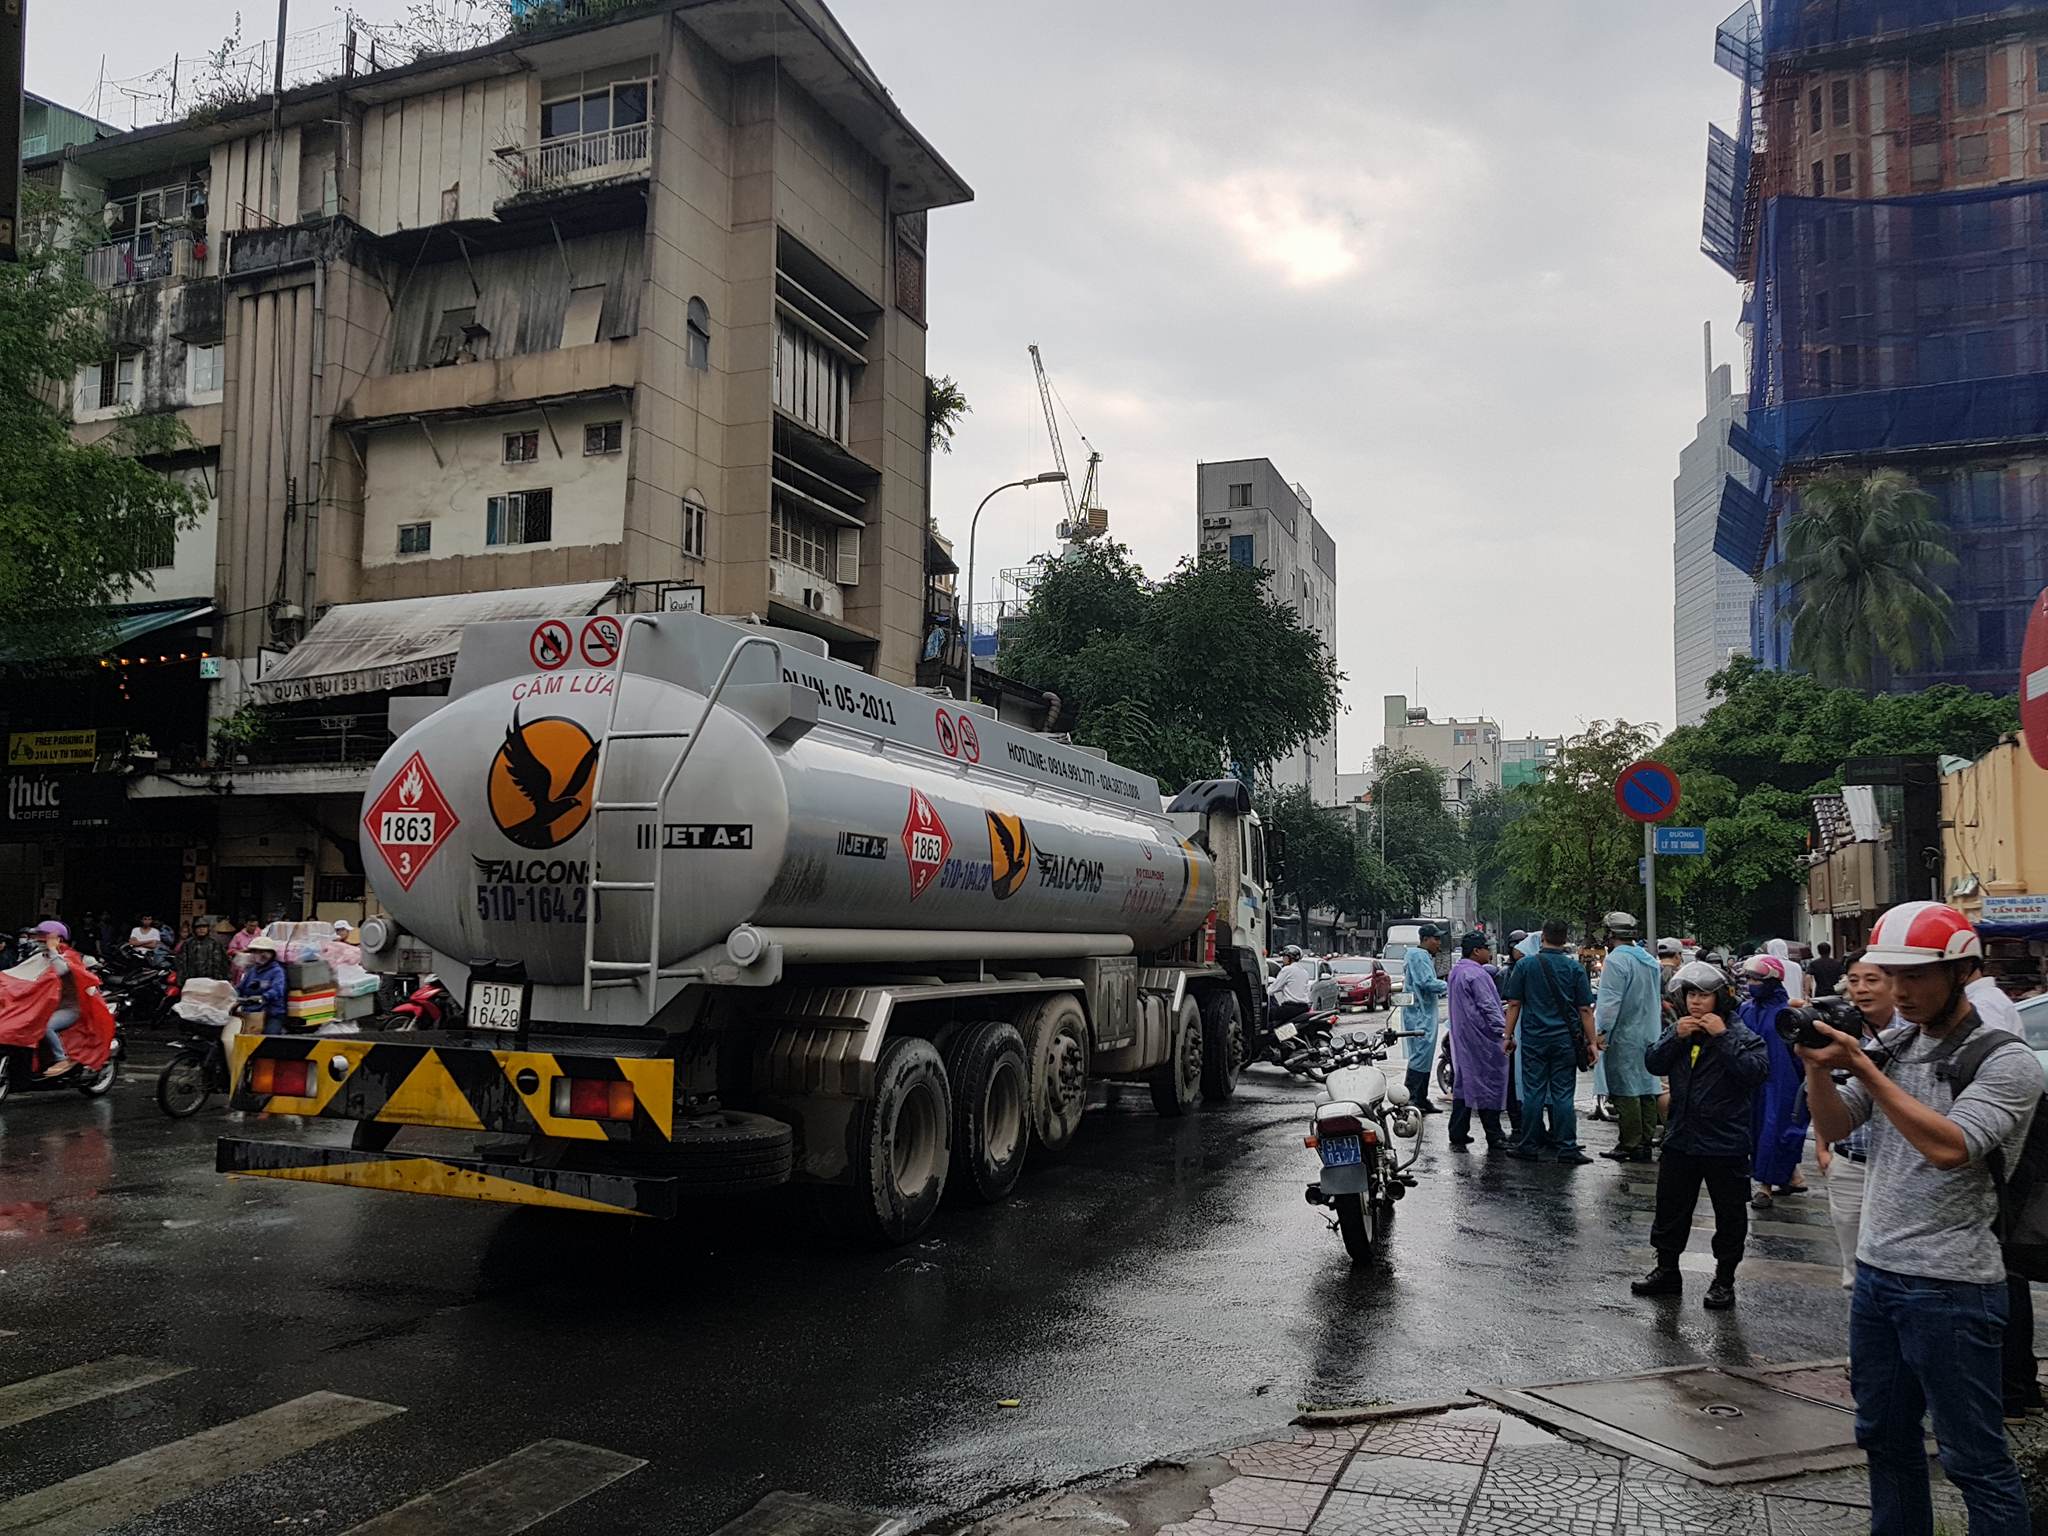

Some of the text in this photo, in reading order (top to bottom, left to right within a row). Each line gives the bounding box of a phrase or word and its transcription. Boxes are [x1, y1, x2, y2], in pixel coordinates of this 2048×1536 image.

[274, 681, 311, 700] QUAN
[315, 679, 338, 694] BUI
[342, 677, 357, 692] 39
[512, 672, 563, 701] CẤM
[834, 684, 897, 726] 05-2011
[34, 734, 95, 746] FREE PARKING AT
[1007, 741, 1048, 772] HOTLINE:
[16, 810, 60, 820] COFFEE
[383, 817, 432, 842] 1863
[663, 826, 751, 846] JET A-1
[847, 835, 888, 857] JET A-1
[914, 836, 941, 862] 1863
[399, 852, 412, 875] 3
[1033, 842, 1104, 894] FALCONS
[916, 868, 927, 888] 3
[472, 1006, 519, 1027] 164.29
